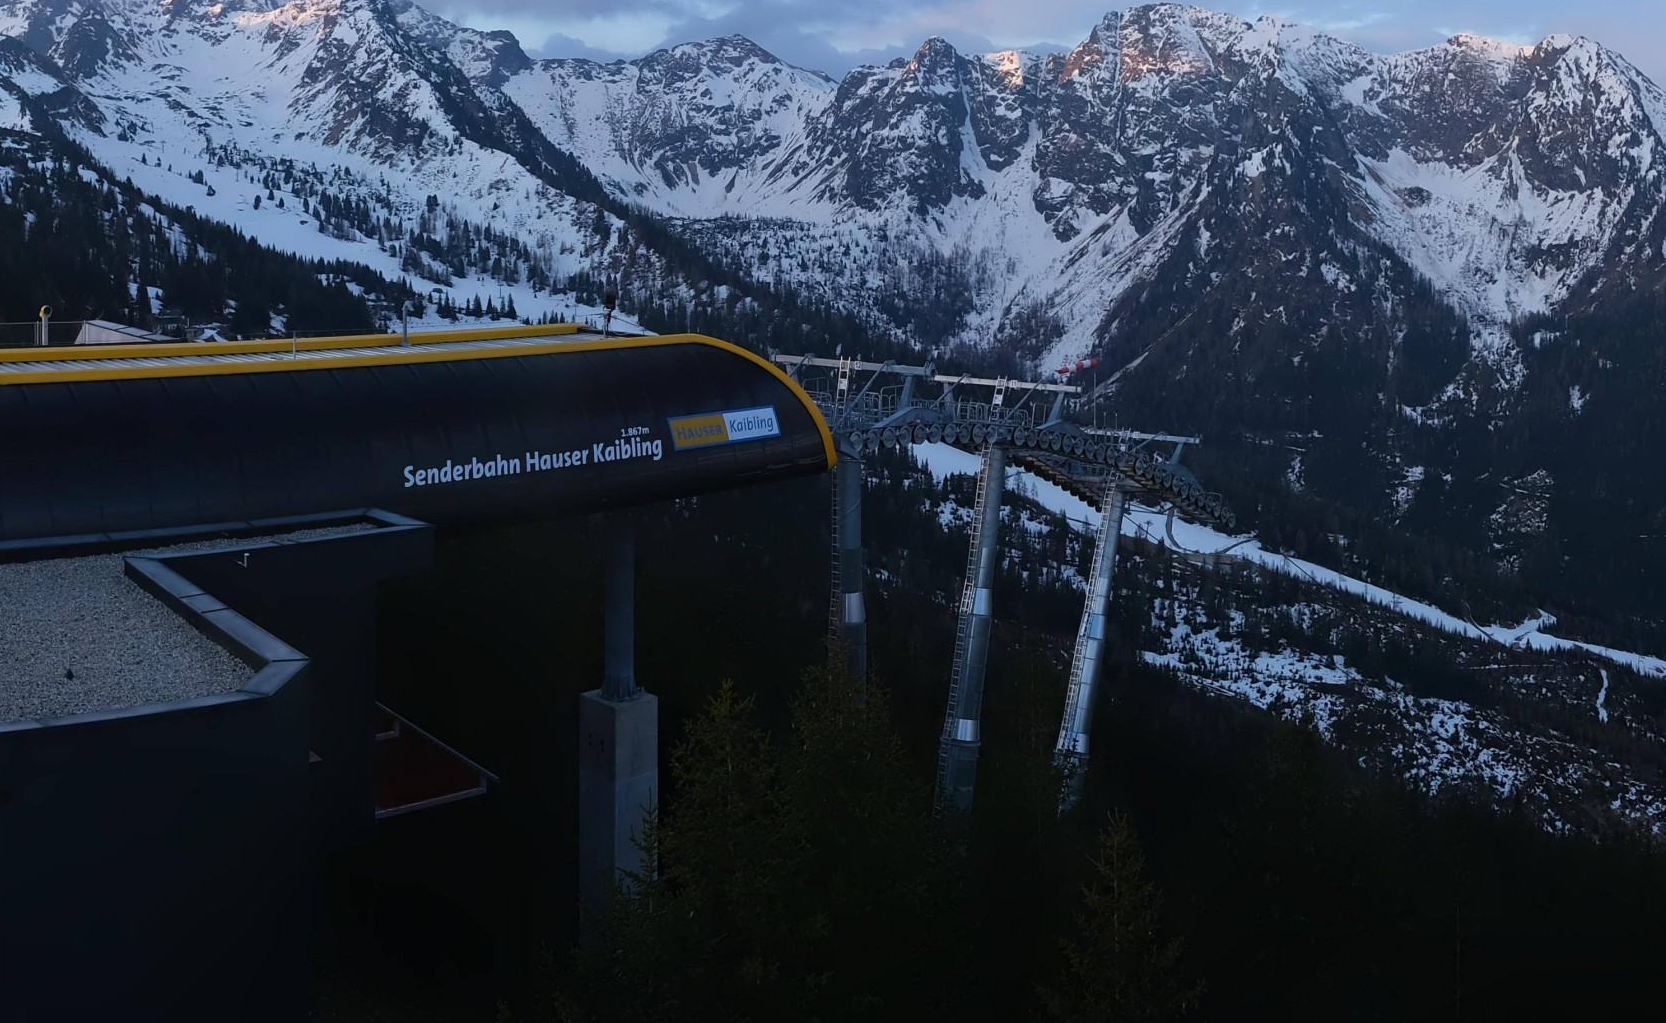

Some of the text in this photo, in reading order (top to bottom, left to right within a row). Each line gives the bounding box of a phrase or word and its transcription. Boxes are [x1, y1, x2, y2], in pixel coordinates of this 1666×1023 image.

[621, 425, 650, 438] 1.867m
[676, 415, 774, 440] HAUSER Kaibling
[403, 435, 663, 488] Senderbahn Hauser Kaibling
